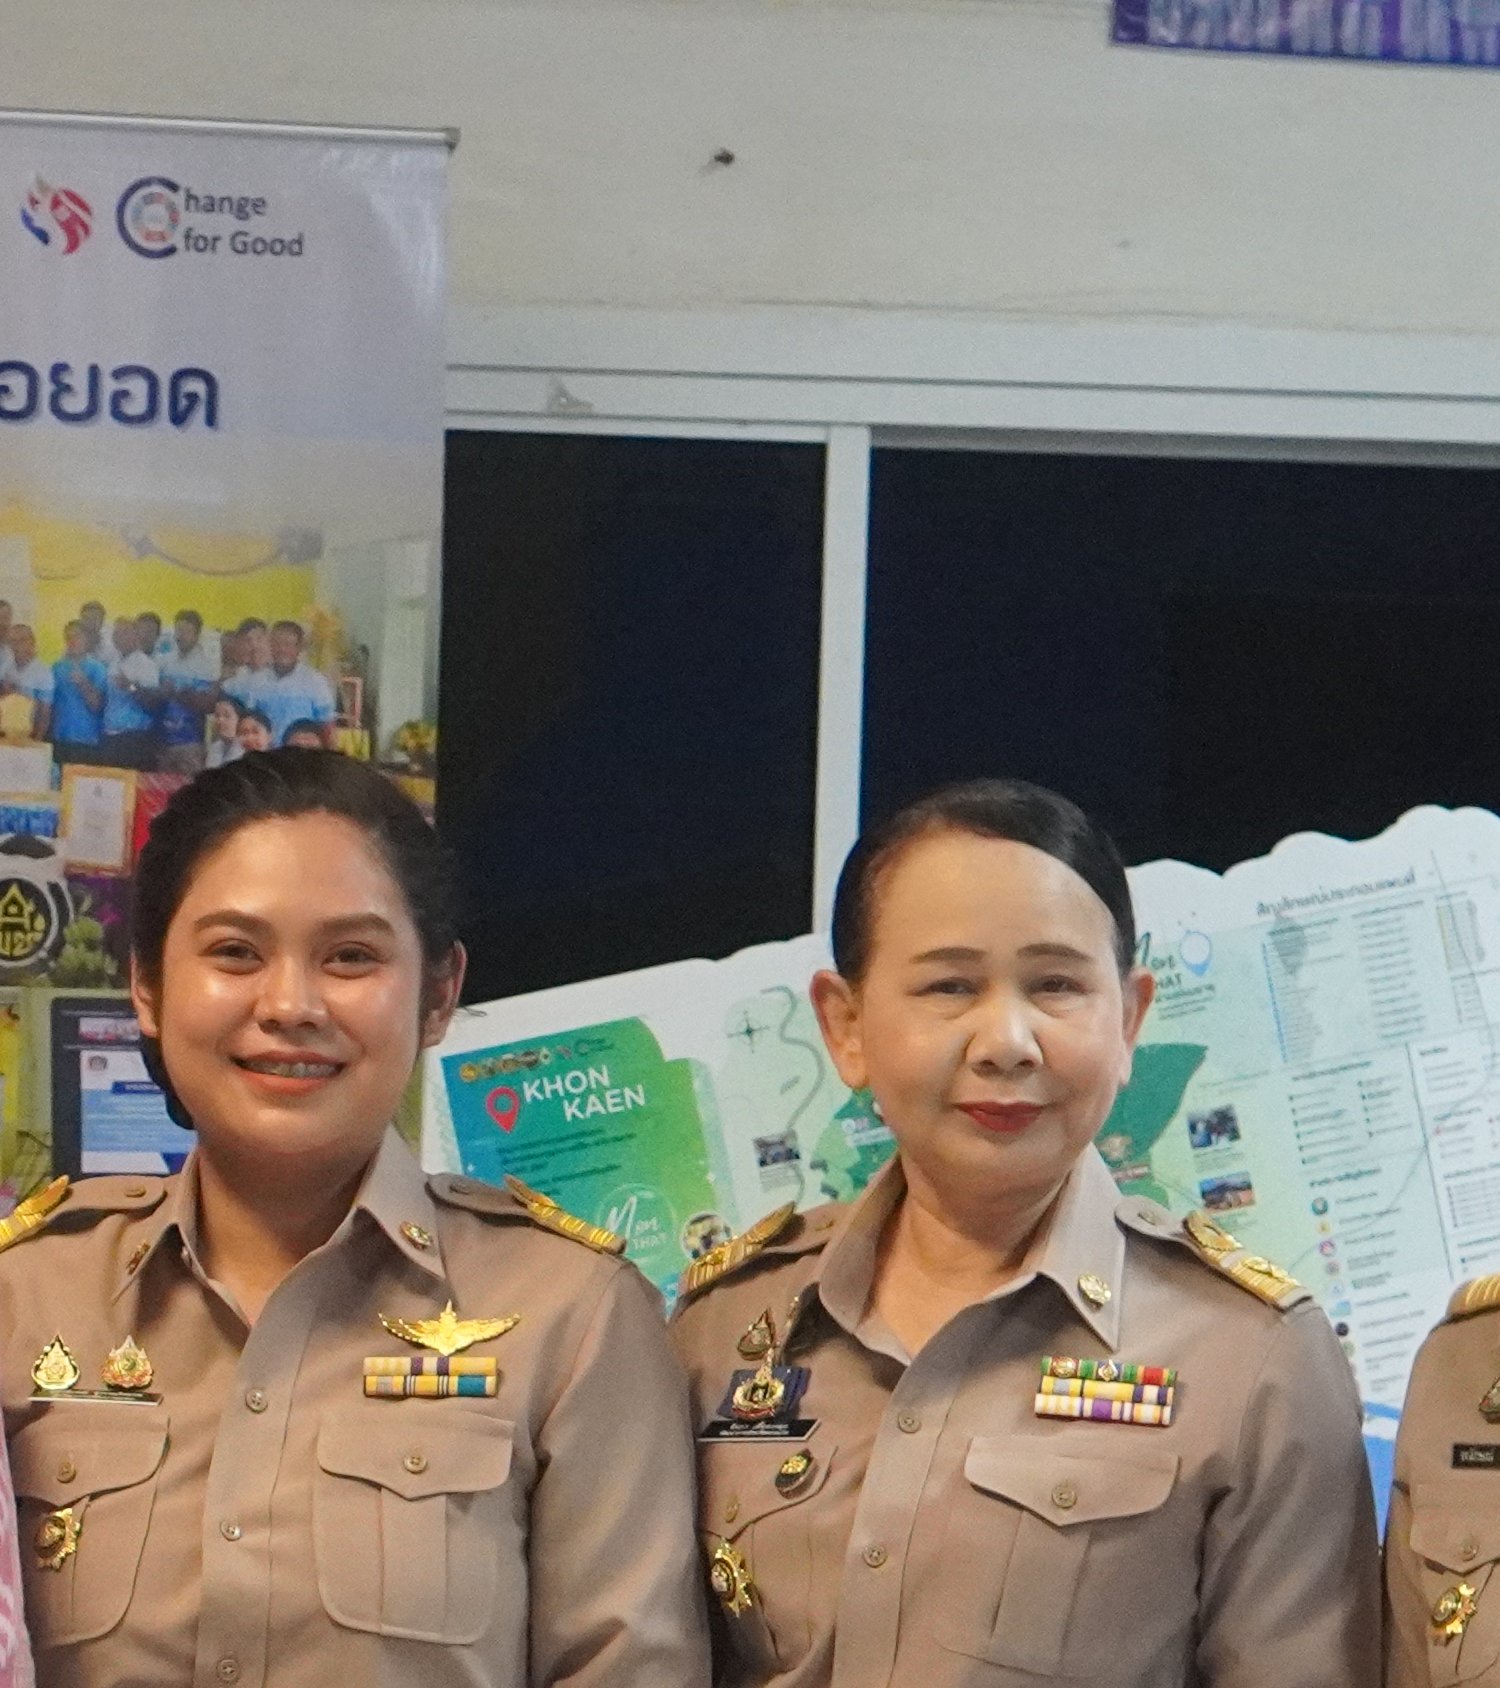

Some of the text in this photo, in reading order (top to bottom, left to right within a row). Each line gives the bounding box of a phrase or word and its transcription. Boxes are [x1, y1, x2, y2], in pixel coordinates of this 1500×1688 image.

[183, 227, 304, 258] for Good
[523, 1064, 611, 1102] KHON
[562, 1084, 646, 1122] KAEN
